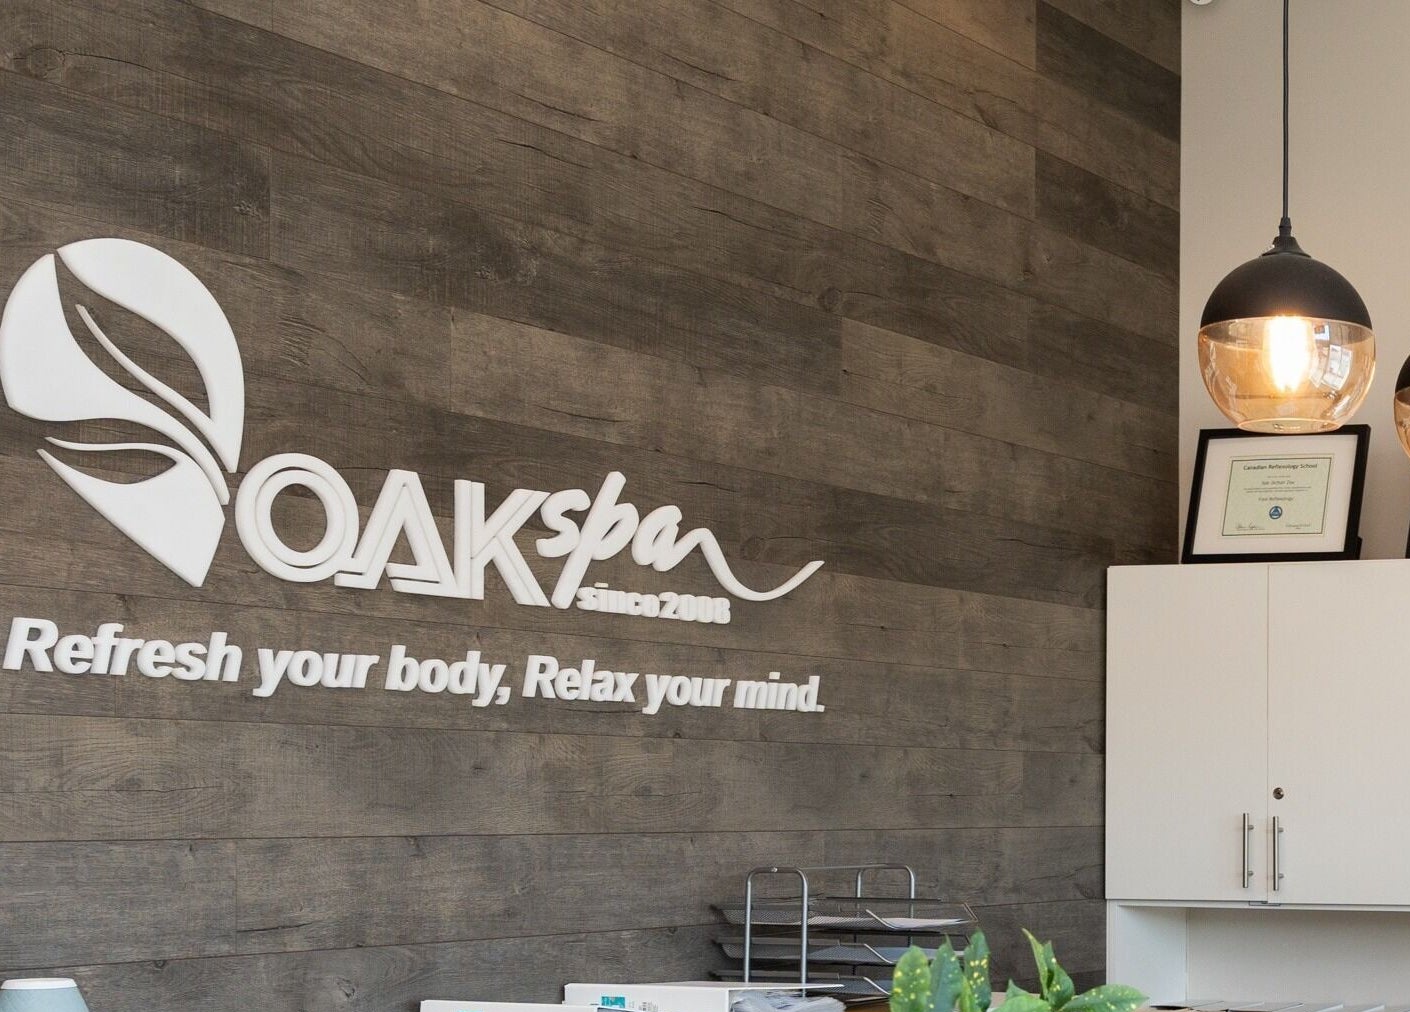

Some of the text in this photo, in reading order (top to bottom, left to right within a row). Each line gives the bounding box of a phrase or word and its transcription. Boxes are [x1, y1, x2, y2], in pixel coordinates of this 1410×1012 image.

[235, 452, 825, 608] OAK spa
[2, 615, 826, 714] Refresh your body, Relax your mind.
